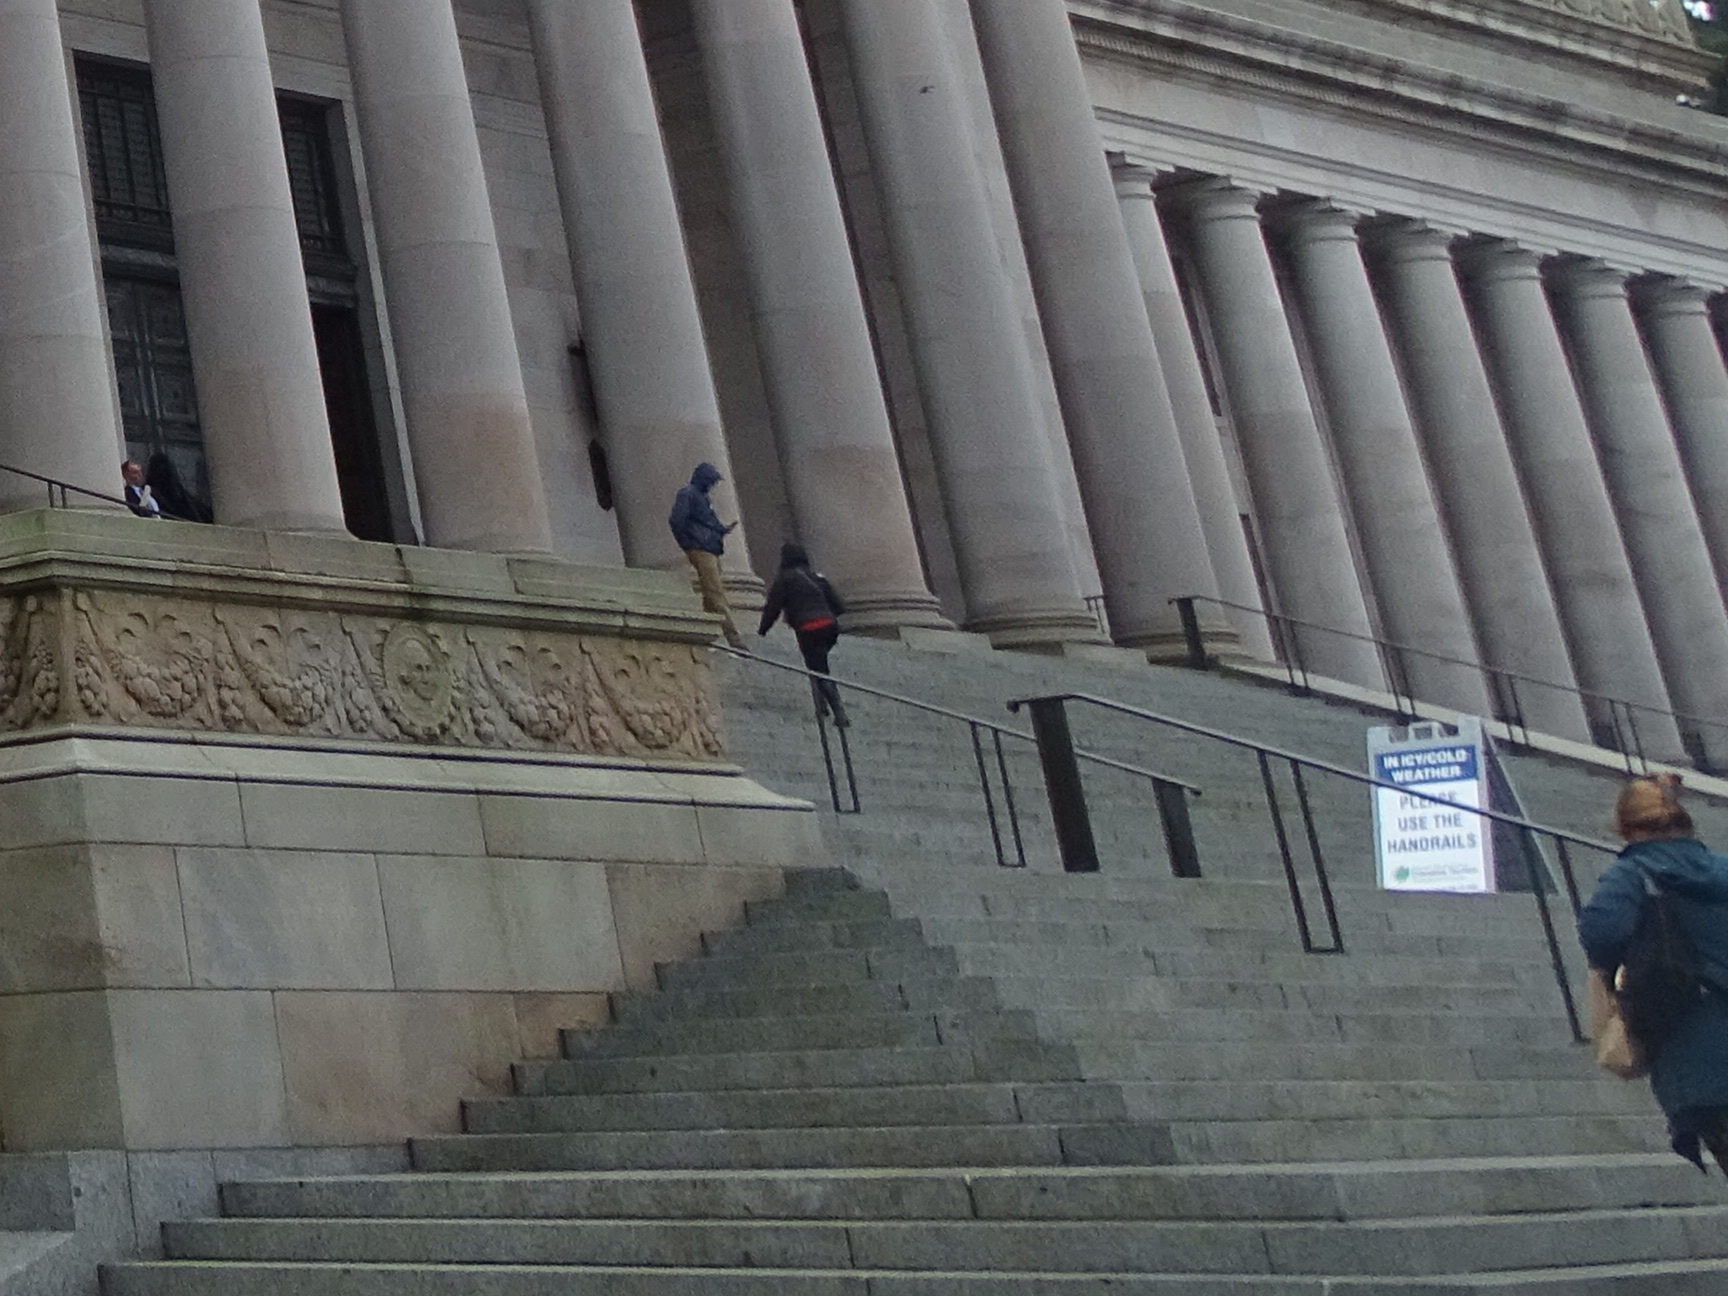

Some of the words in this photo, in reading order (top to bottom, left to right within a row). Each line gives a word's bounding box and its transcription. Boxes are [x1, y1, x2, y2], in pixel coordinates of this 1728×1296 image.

[1383, 755, 1399, 769] IN
[1401, 749, 1467, 767] ICY/COLD
[1392, 765, 1461, 783] WEATHER
[1397, 815, 1428, 832] USE
[1433, 812, 1463, 829] THE
[1387, 832, 1477, 854] HANDRAILS
